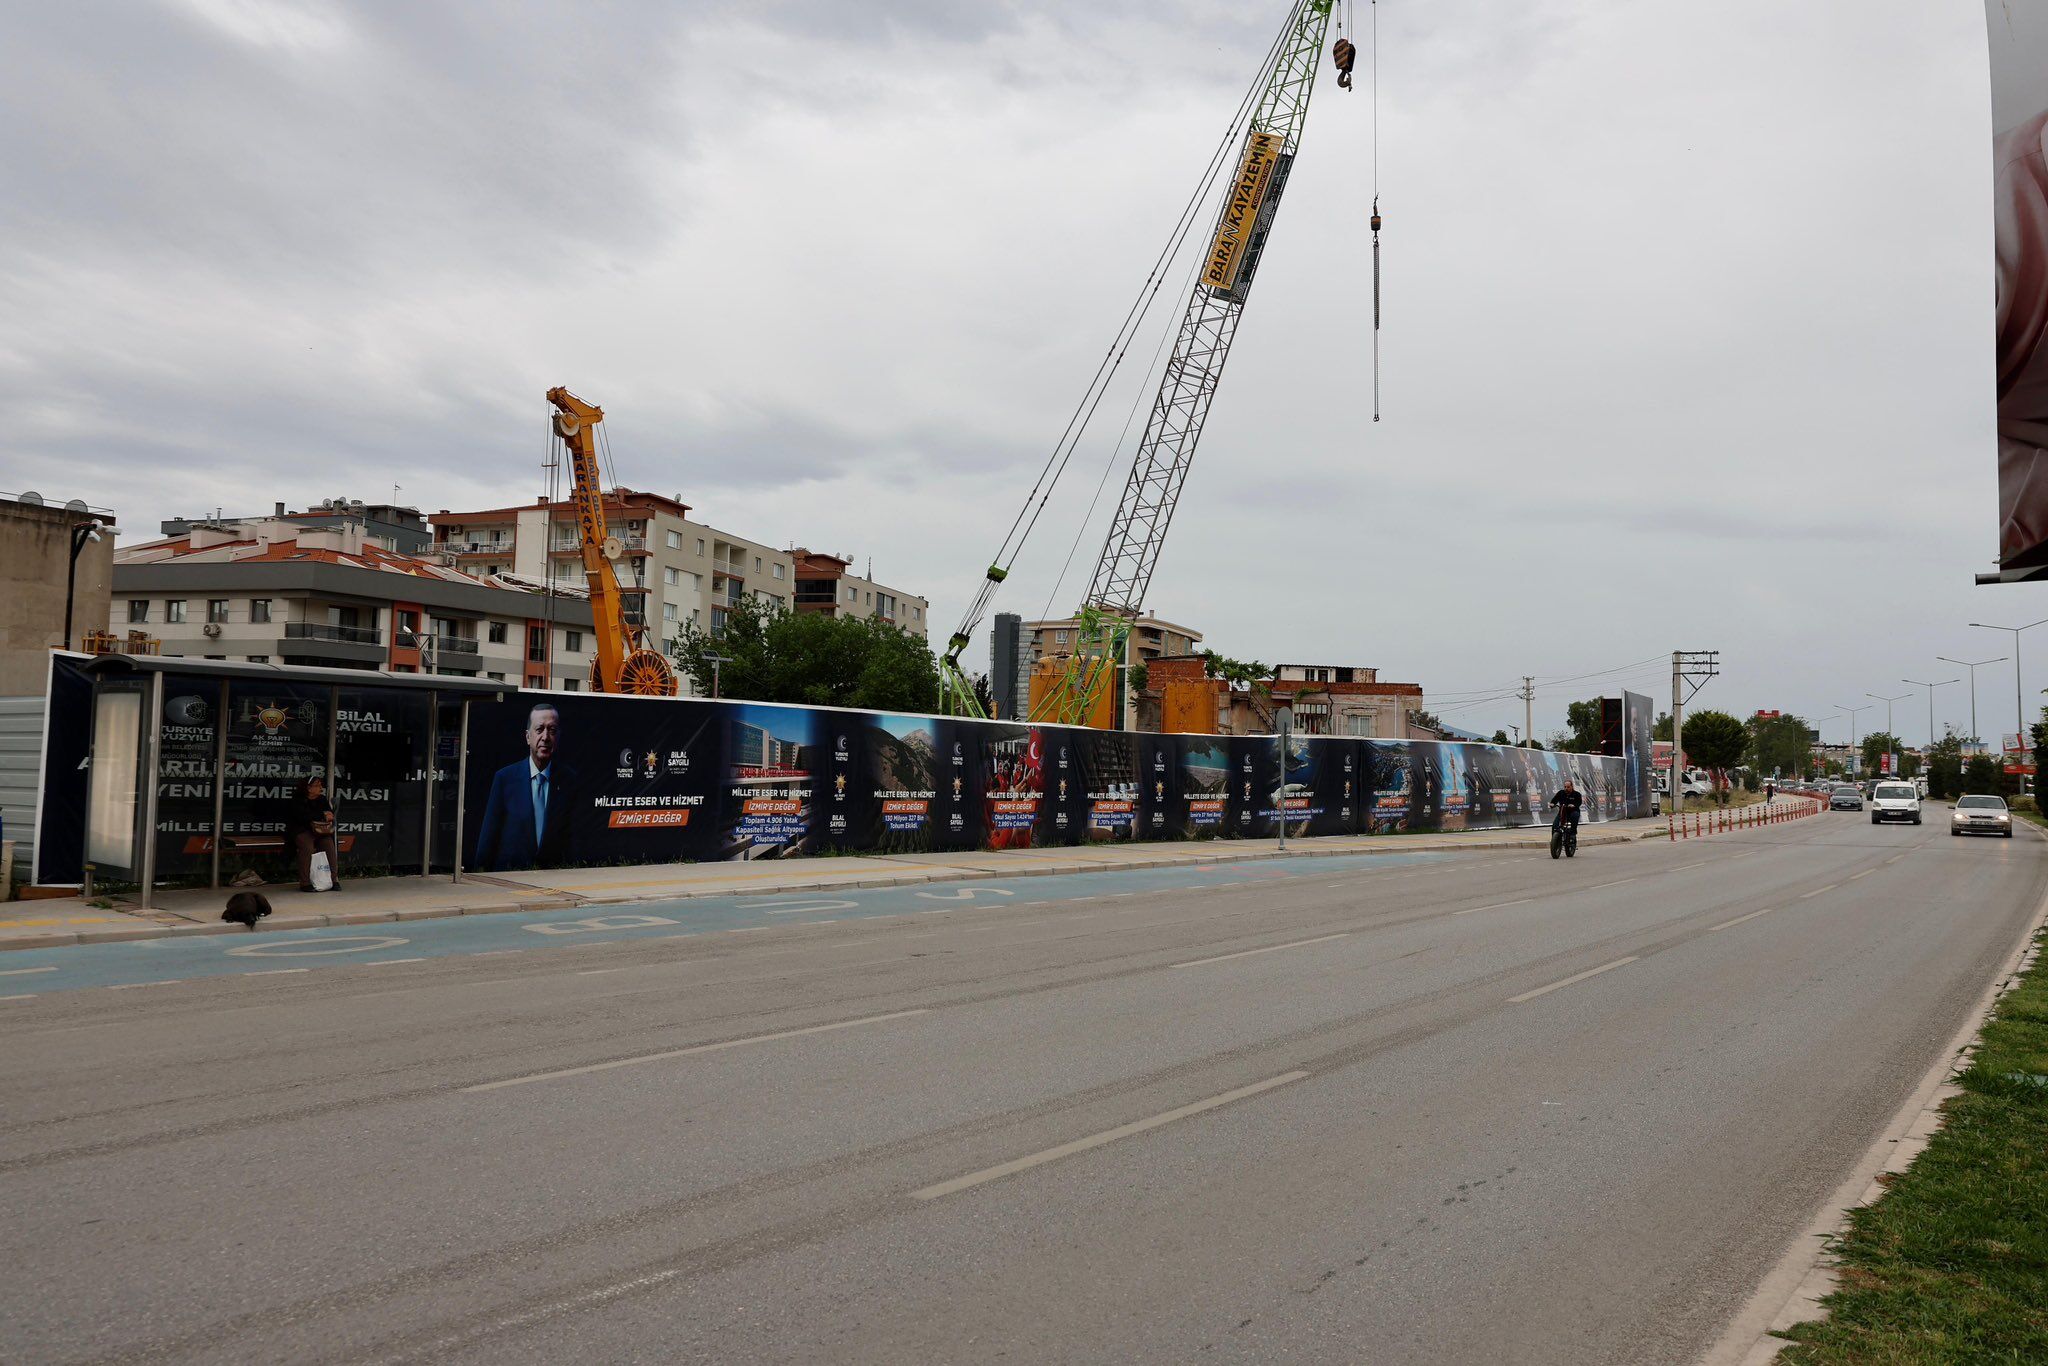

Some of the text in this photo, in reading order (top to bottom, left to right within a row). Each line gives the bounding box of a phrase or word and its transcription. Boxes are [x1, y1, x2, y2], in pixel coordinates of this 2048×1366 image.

[1252, 161, 1272, 208] CONSTRUCTION
[731, 787, 812, 797] MİLLETE ESER VE HİZMET
[874, 789, 896, 798] MİLLETE
[918, 789, 936, 798] HİZMET
[986, 790, 1006, 798] MİLLETE
[594, 794, 704, 807] MİLLETE ESER VE HİZMET
[748, 801, 796, 811] İZMİR'E DEĞER
[616, 811, 682, 824] İZMİR'E DEĞER
[745, 816, 766, 825] Toplam
[784, 816, 798, 824] Yatak
[240, 822, 286, 832] ESER
[735, 825, 763, 834] Kapasiteli
